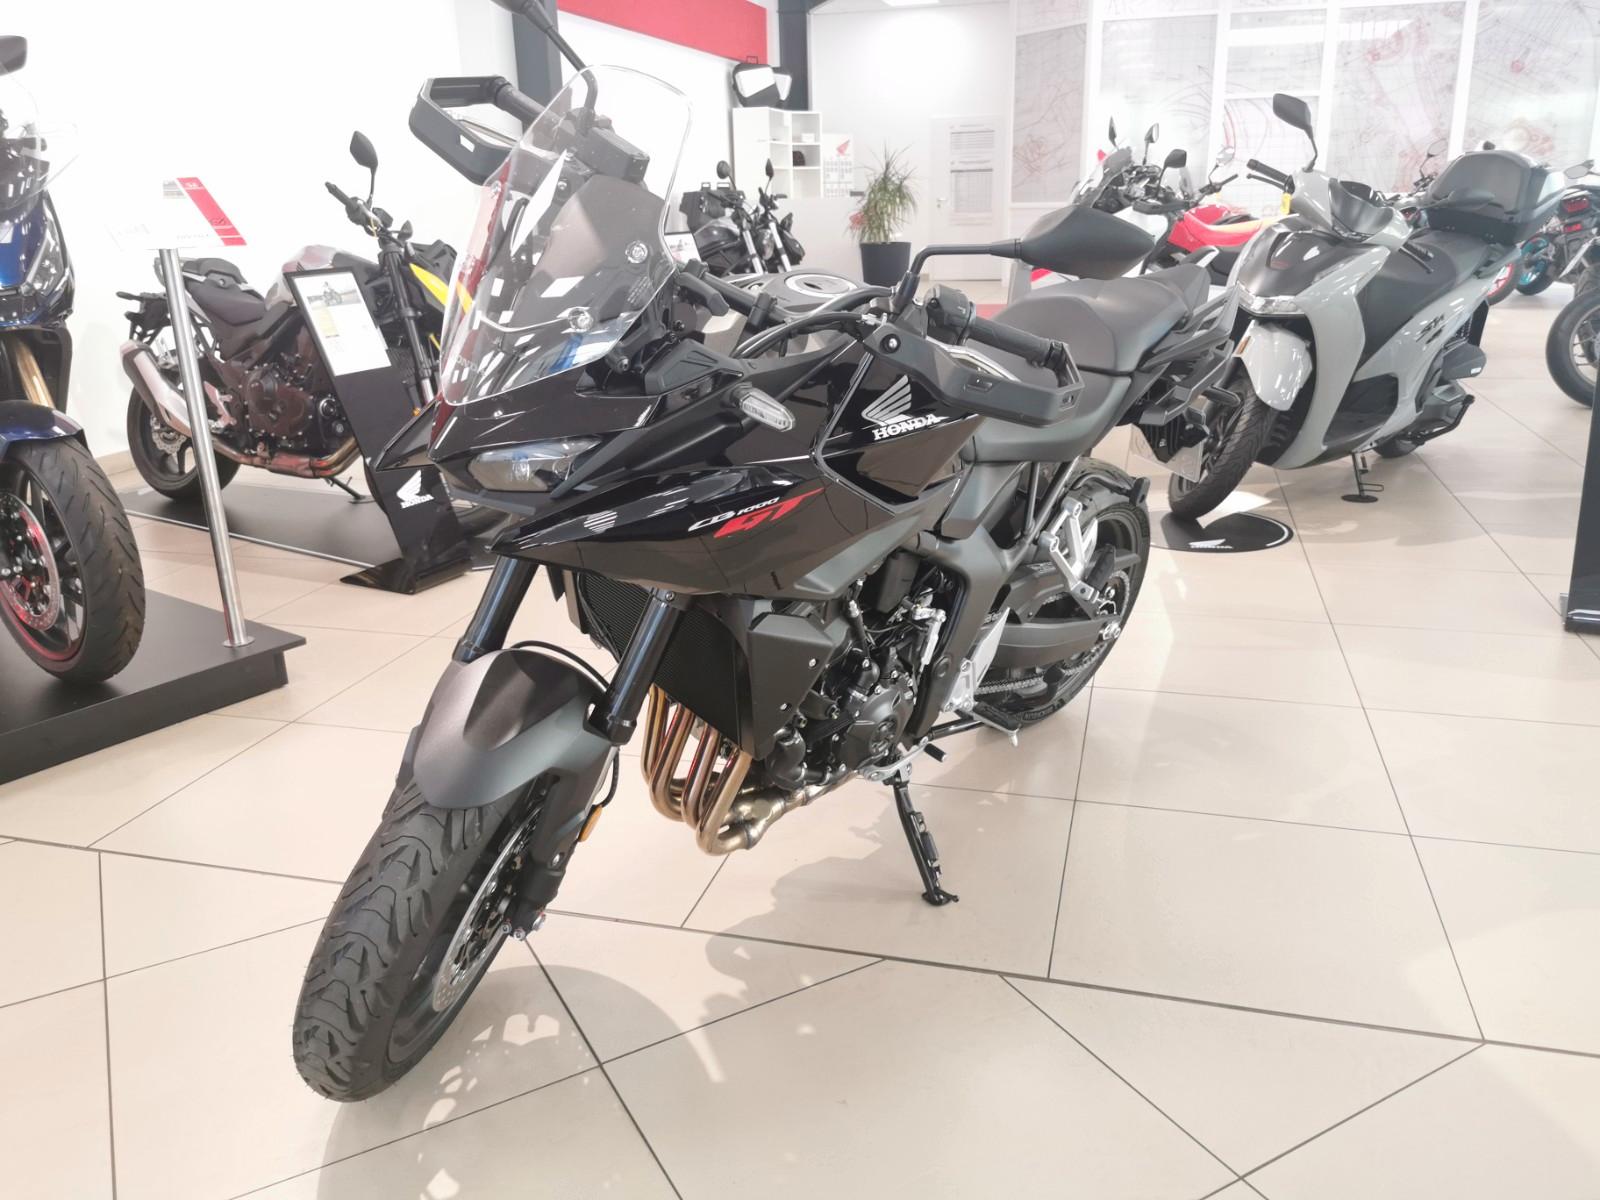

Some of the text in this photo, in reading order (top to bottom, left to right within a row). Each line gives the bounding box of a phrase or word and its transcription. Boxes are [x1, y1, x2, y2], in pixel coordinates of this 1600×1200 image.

[872, 413, 949, 441] HONDA
[400, 494, 434, 508] HONDA
[713, 487, 825, 538] GT
